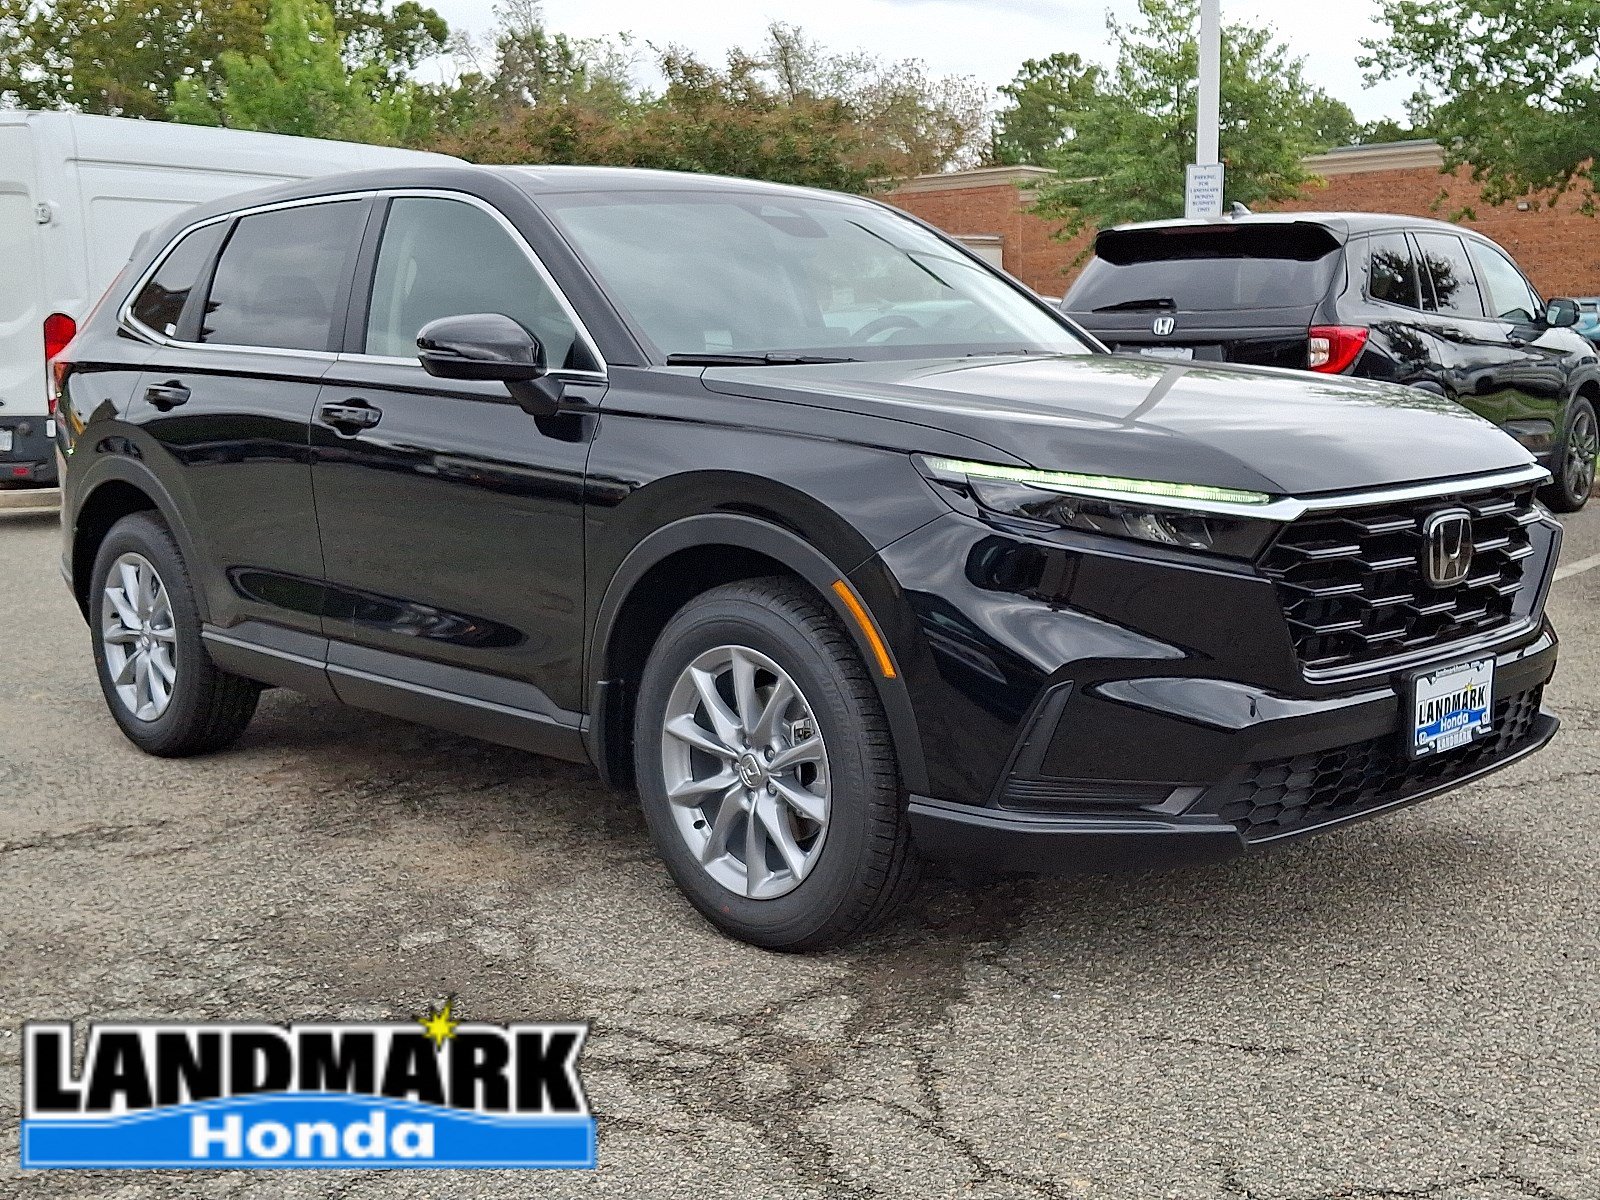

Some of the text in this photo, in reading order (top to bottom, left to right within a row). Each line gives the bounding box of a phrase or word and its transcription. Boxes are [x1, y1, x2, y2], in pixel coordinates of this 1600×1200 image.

[1418, 685, 1486, 725] LANDMARK
[1440, 711, 1469, 733] Honda
[1437, 730, 1473, 751] LANDMARK
